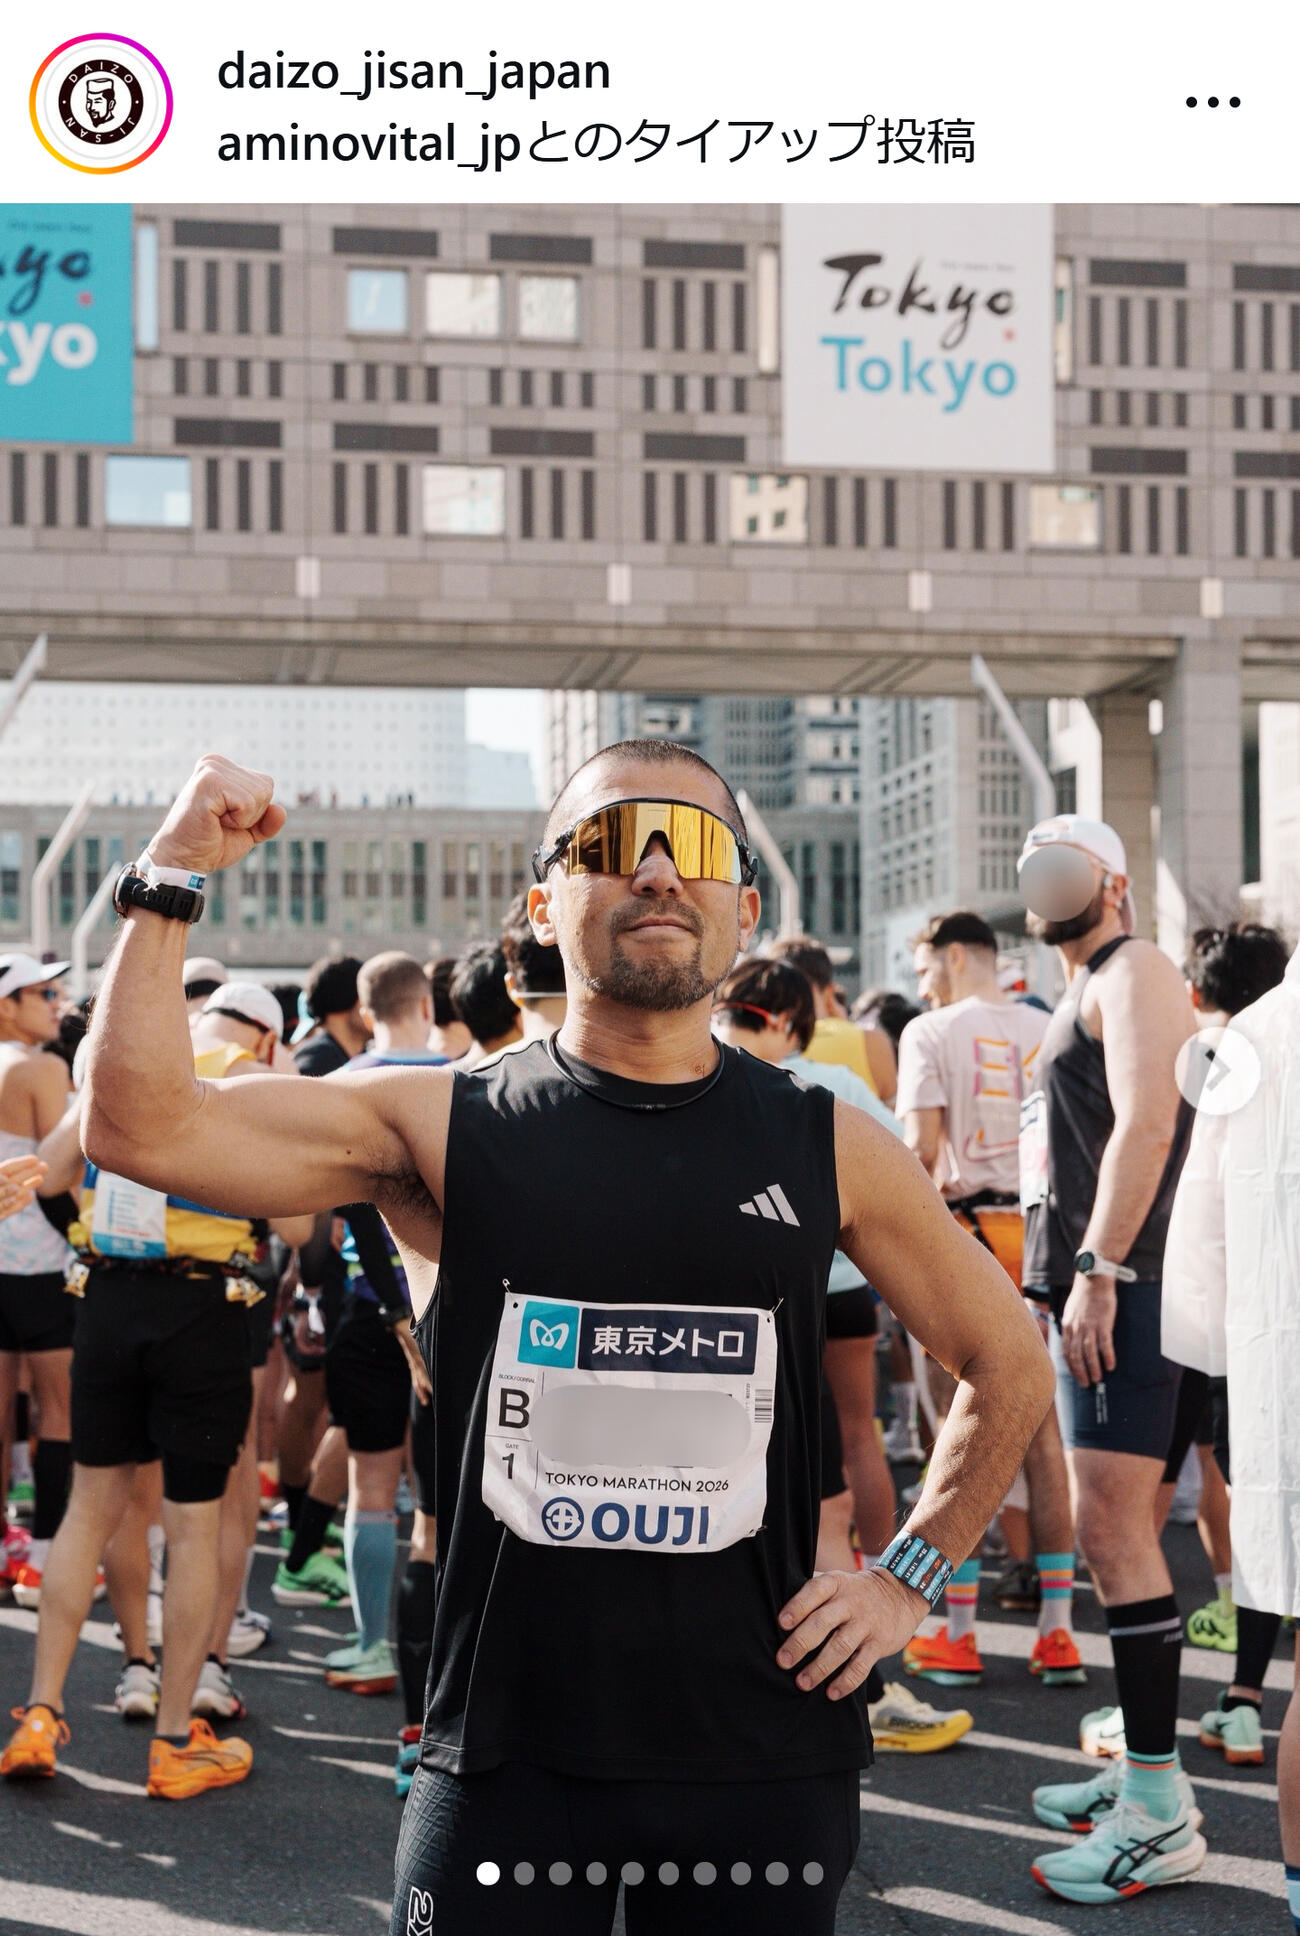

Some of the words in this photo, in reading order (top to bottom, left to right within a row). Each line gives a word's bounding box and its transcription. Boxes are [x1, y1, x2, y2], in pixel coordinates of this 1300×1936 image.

[0, 244, 92, 316] yo
[822, 252, 1016, 351] Tokyo
[820, 335, 1016, 413] Tokyo
[591, 1325, 745, 1358] 東京メトロ
[498, 1387, 530, 1429] B
[502, 1452, 515, 1480] 1
[545, 1471, 599, 1487] TOKYO
[603, 1477, 692, 1493] MARATHON
[696, 1479, 730, 1493] 2026
[591, 1502, 710, 1546] OUJI
